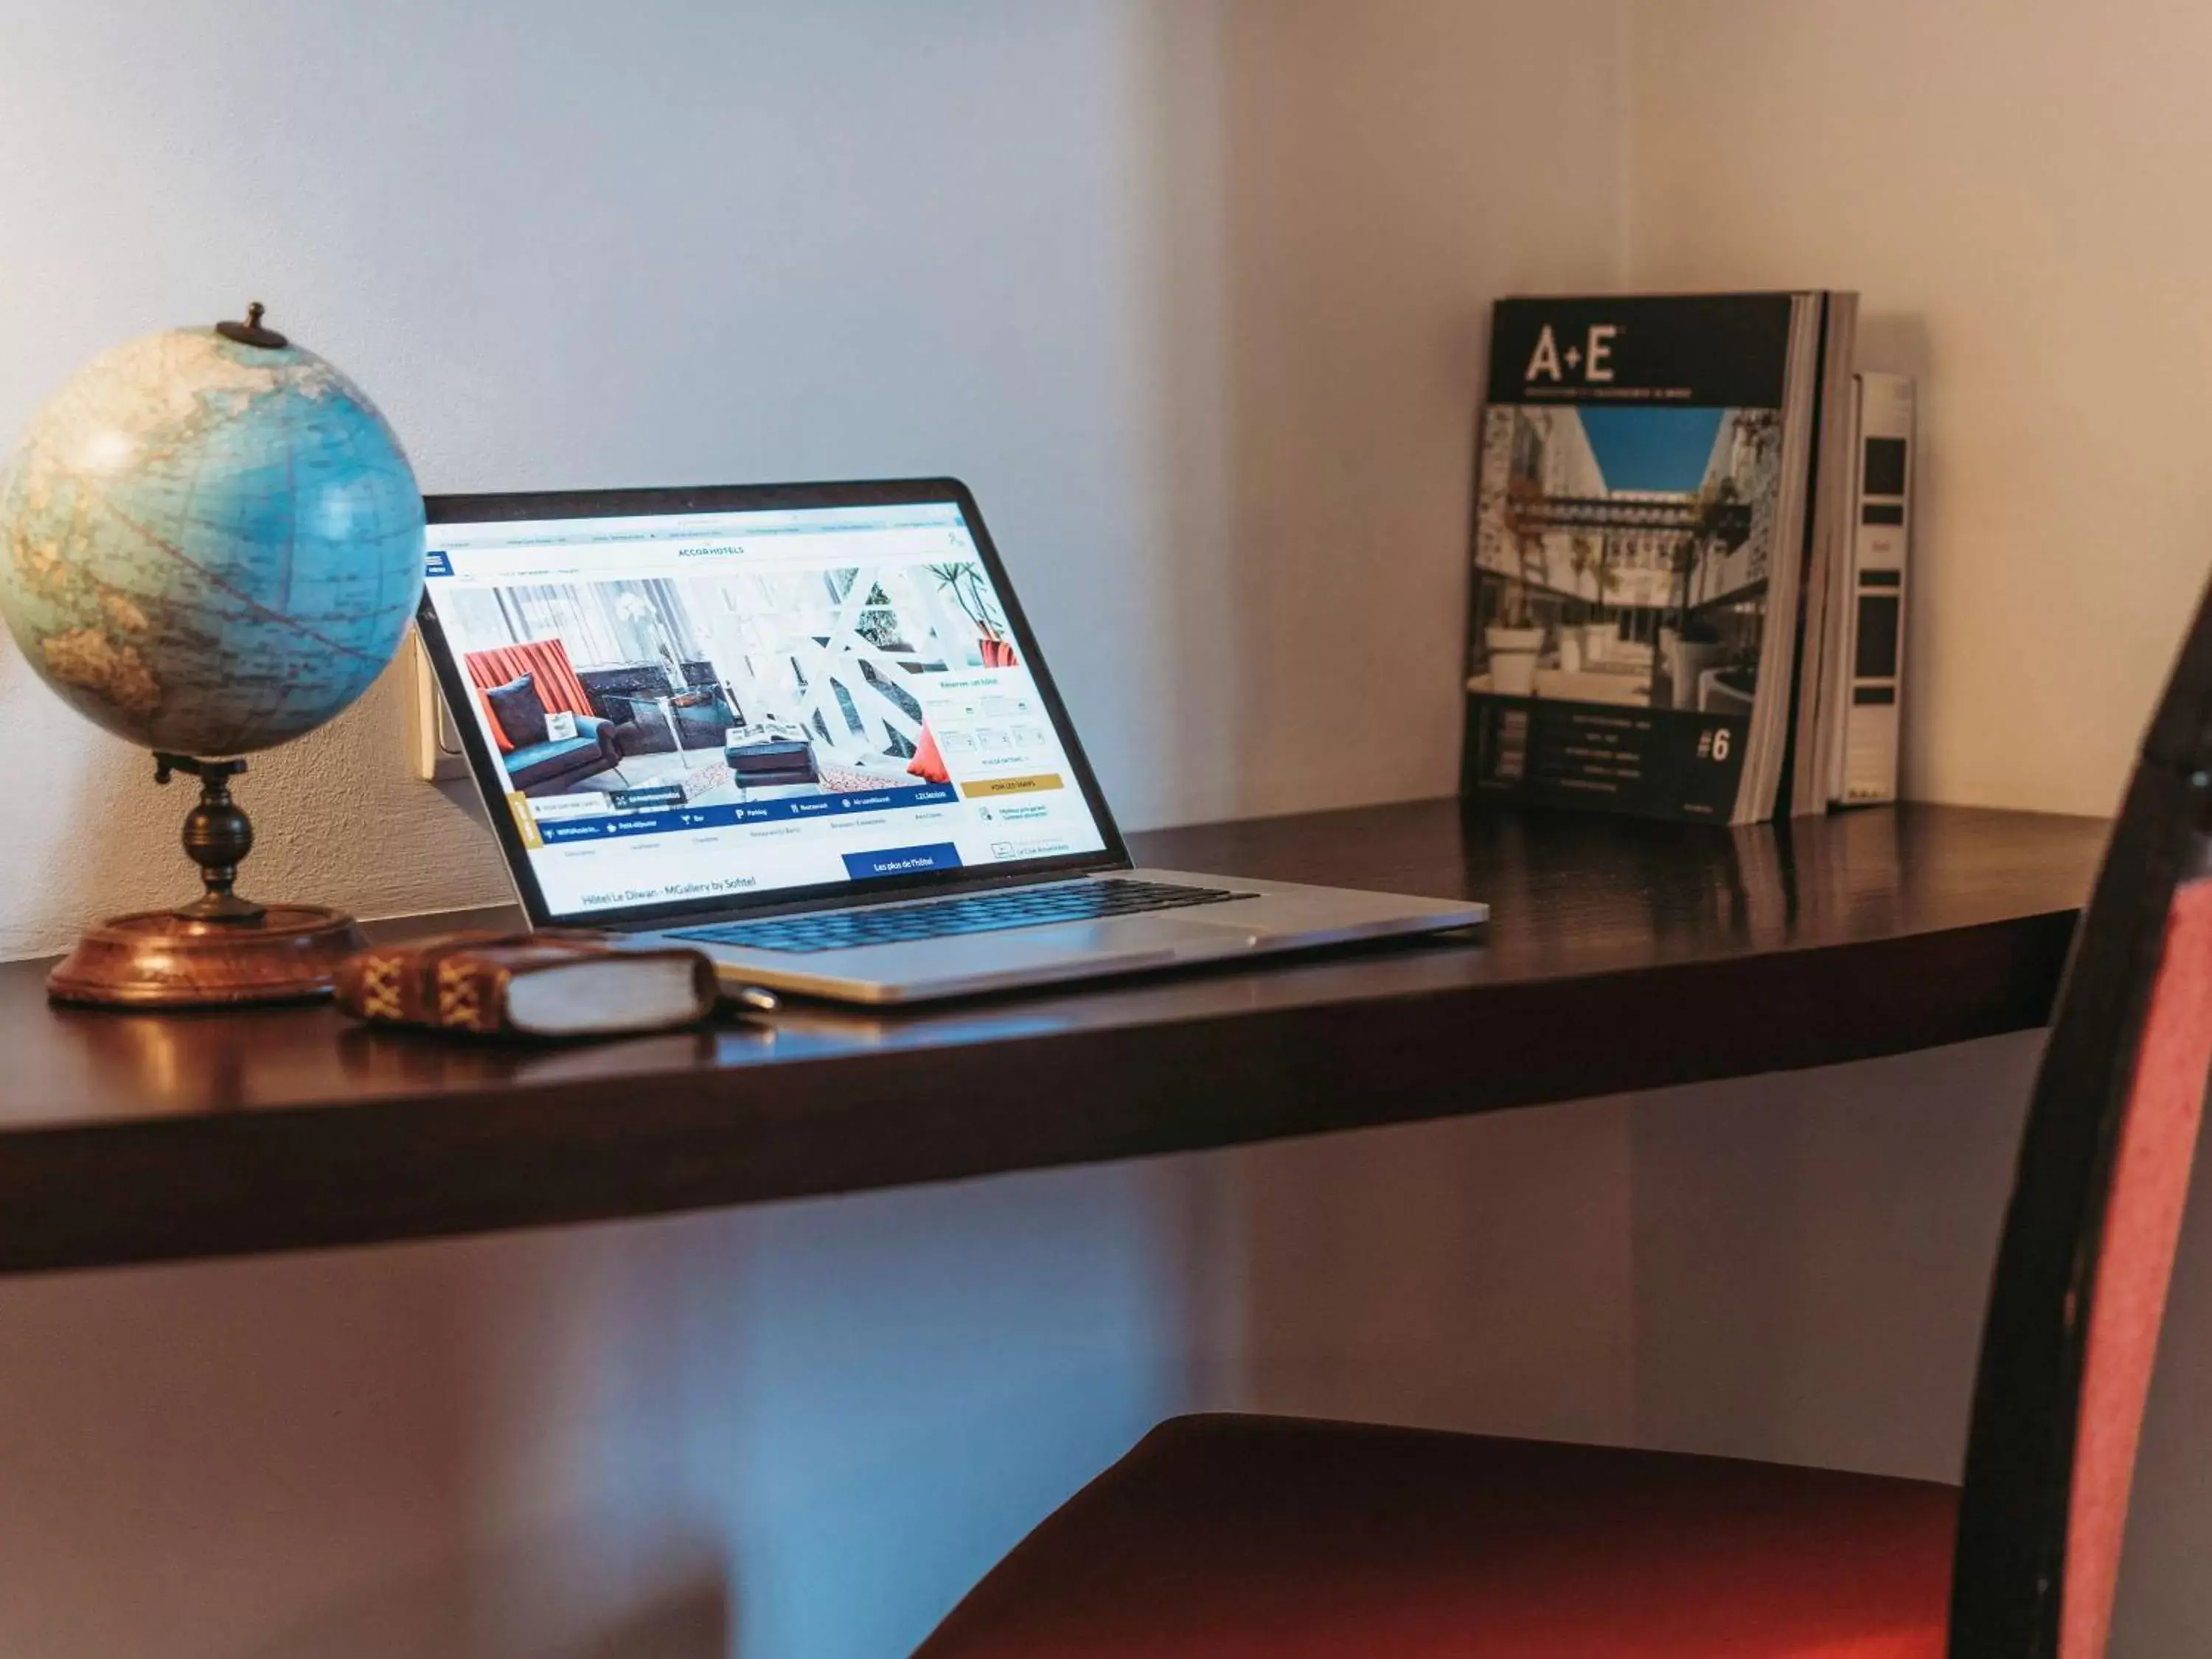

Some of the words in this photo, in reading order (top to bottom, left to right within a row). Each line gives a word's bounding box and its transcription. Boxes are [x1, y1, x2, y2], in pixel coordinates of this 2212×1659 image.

[678, 546, 744, 557] ACCORHOTELS
[873, 863, 887, 872] Les
[887, 861, 902, 872] plus
[582, 893, 611, 905] Hôtel
[613, 892, 624, 902] Le
[627, 888, 657, 900] Diwan
[664, 882, 709, 896] MGallery
[712, 880, 724, 892] by
[725, 876, 757, 889] Sofitel
